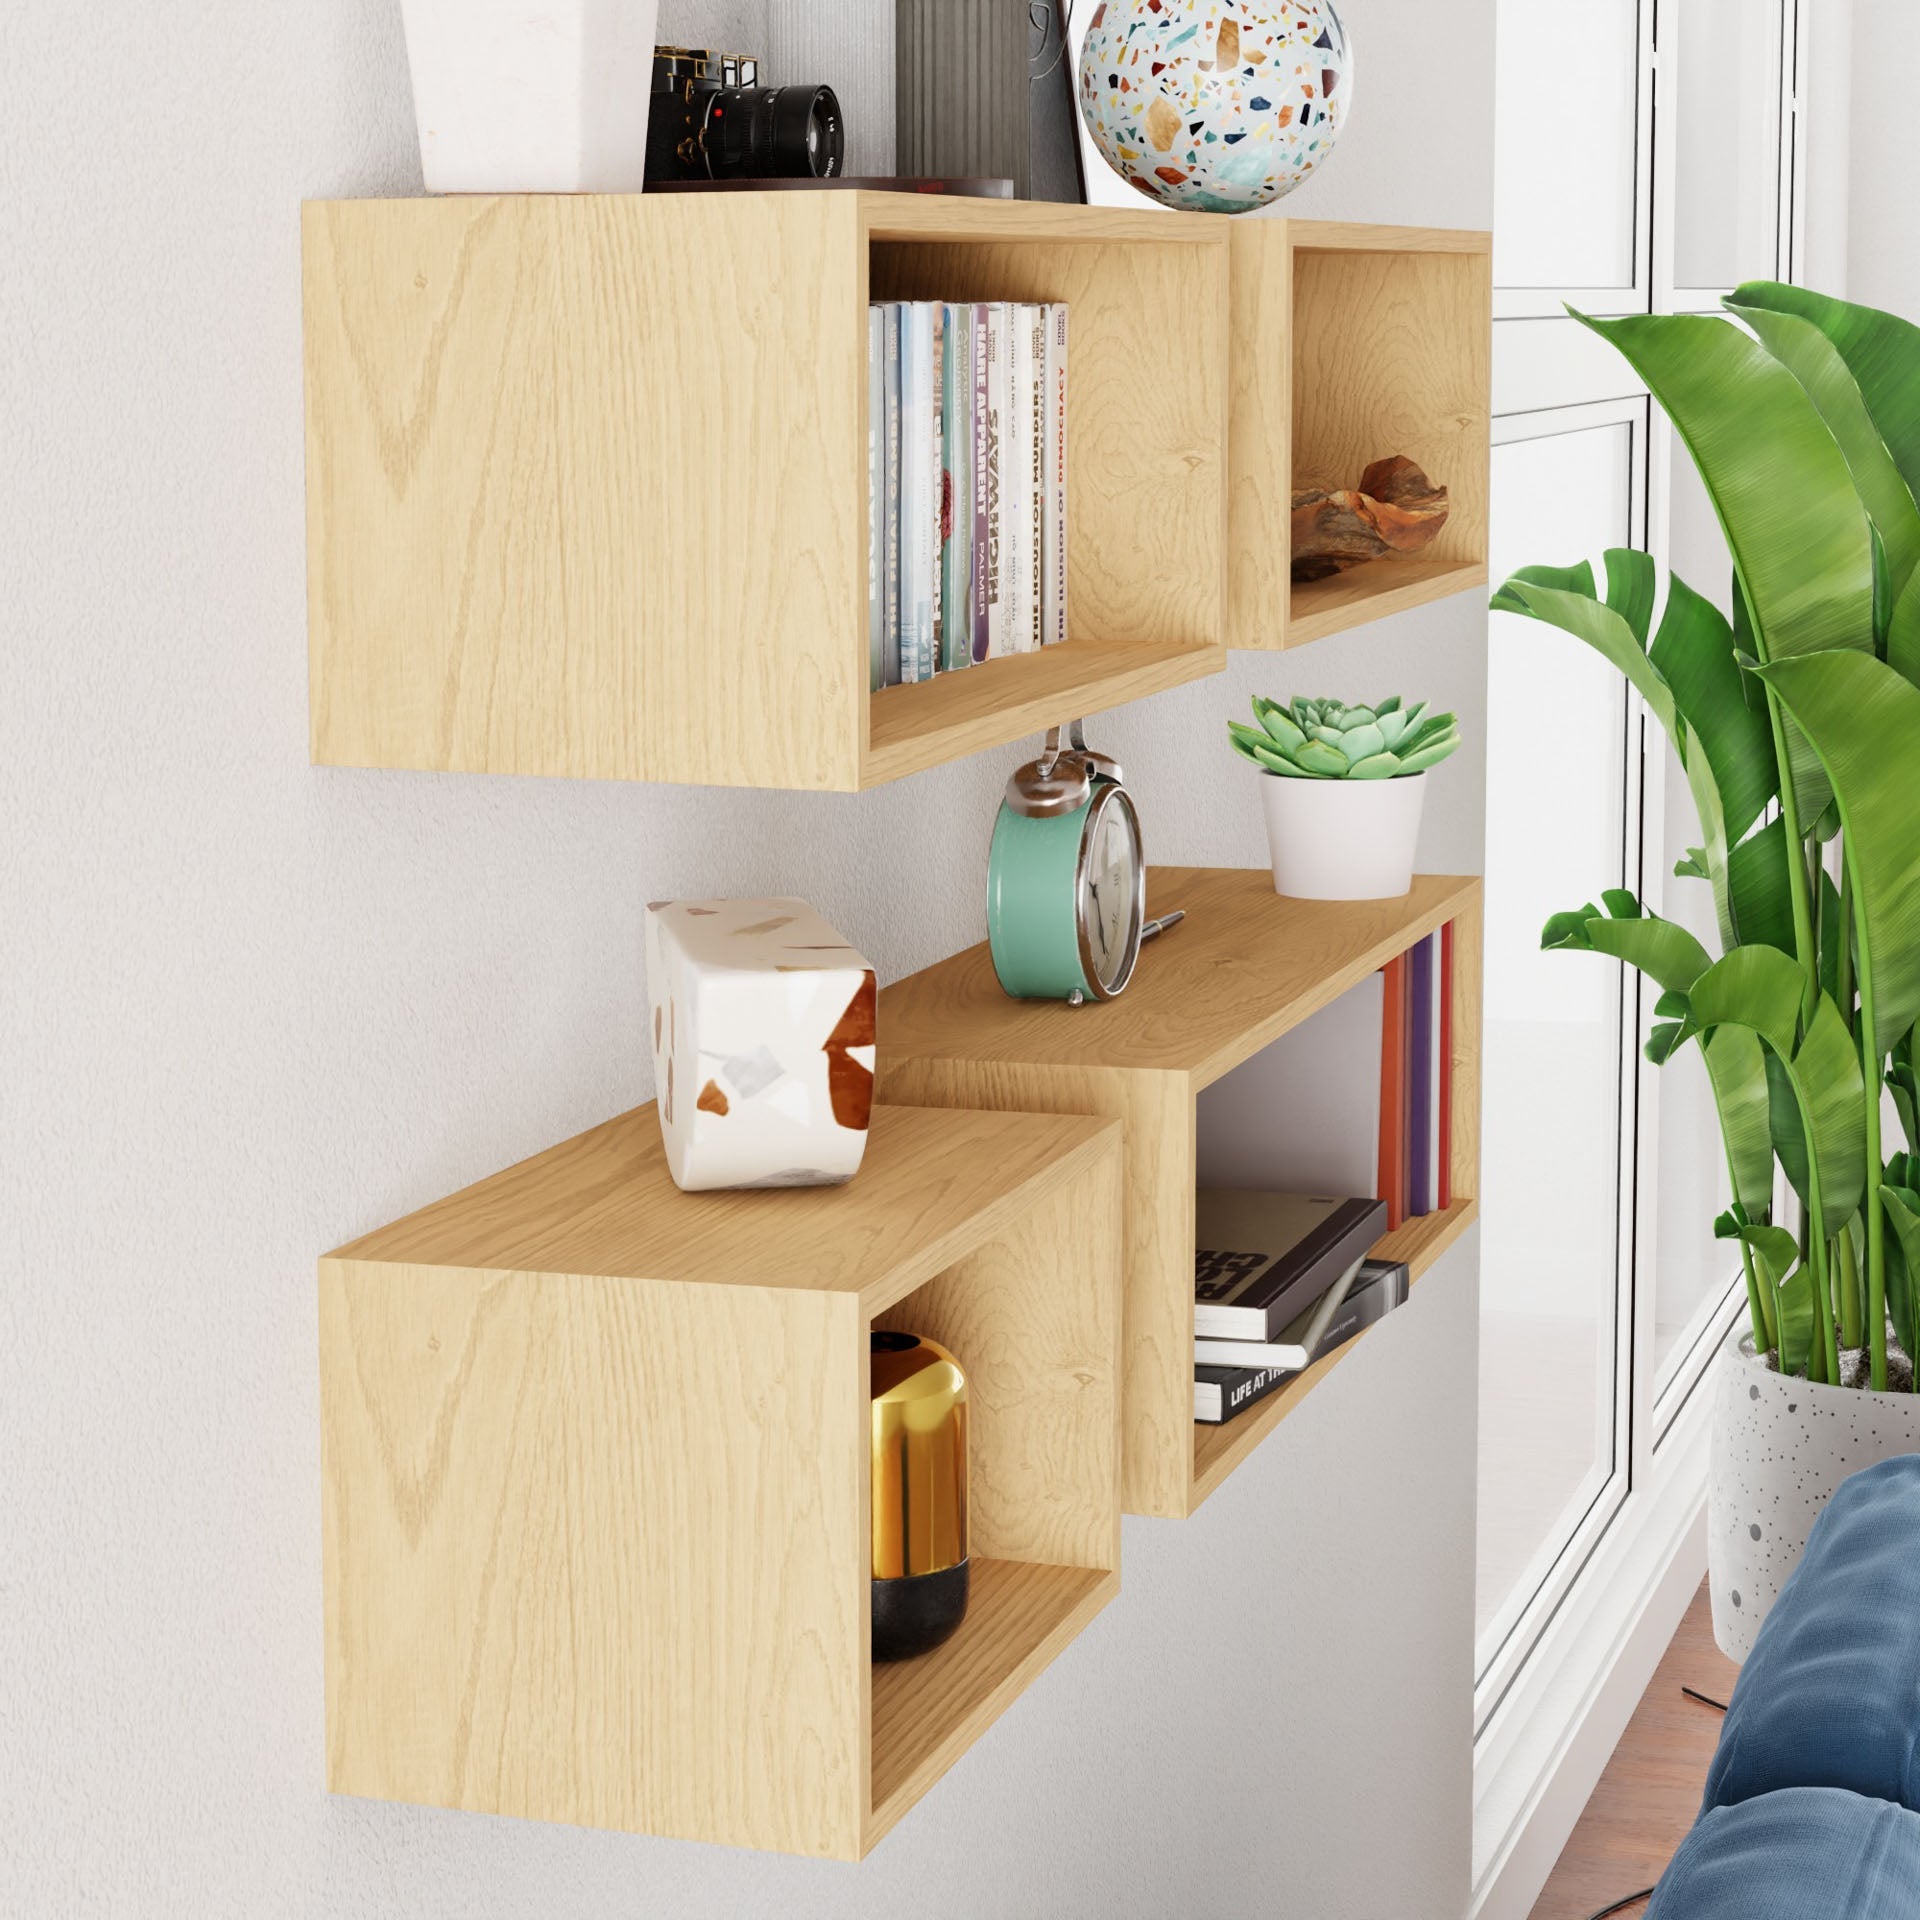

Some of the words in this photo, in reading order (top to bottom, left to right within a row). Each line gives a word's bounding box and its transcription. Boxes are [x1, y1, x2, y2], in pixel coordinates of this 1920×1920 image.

[976, 323, 986, 388] HARE
[890, 395, 898, 501] GAMBLE
[976, 392, 986, 516] APPARENT
[988, 409, 999, 605] HIGHWAYS
[1059, 489, 1064, 513] OF
[1231, 1380, 1253, 1407] LIFE
[1253, 1370, 1266, 1392] AT
